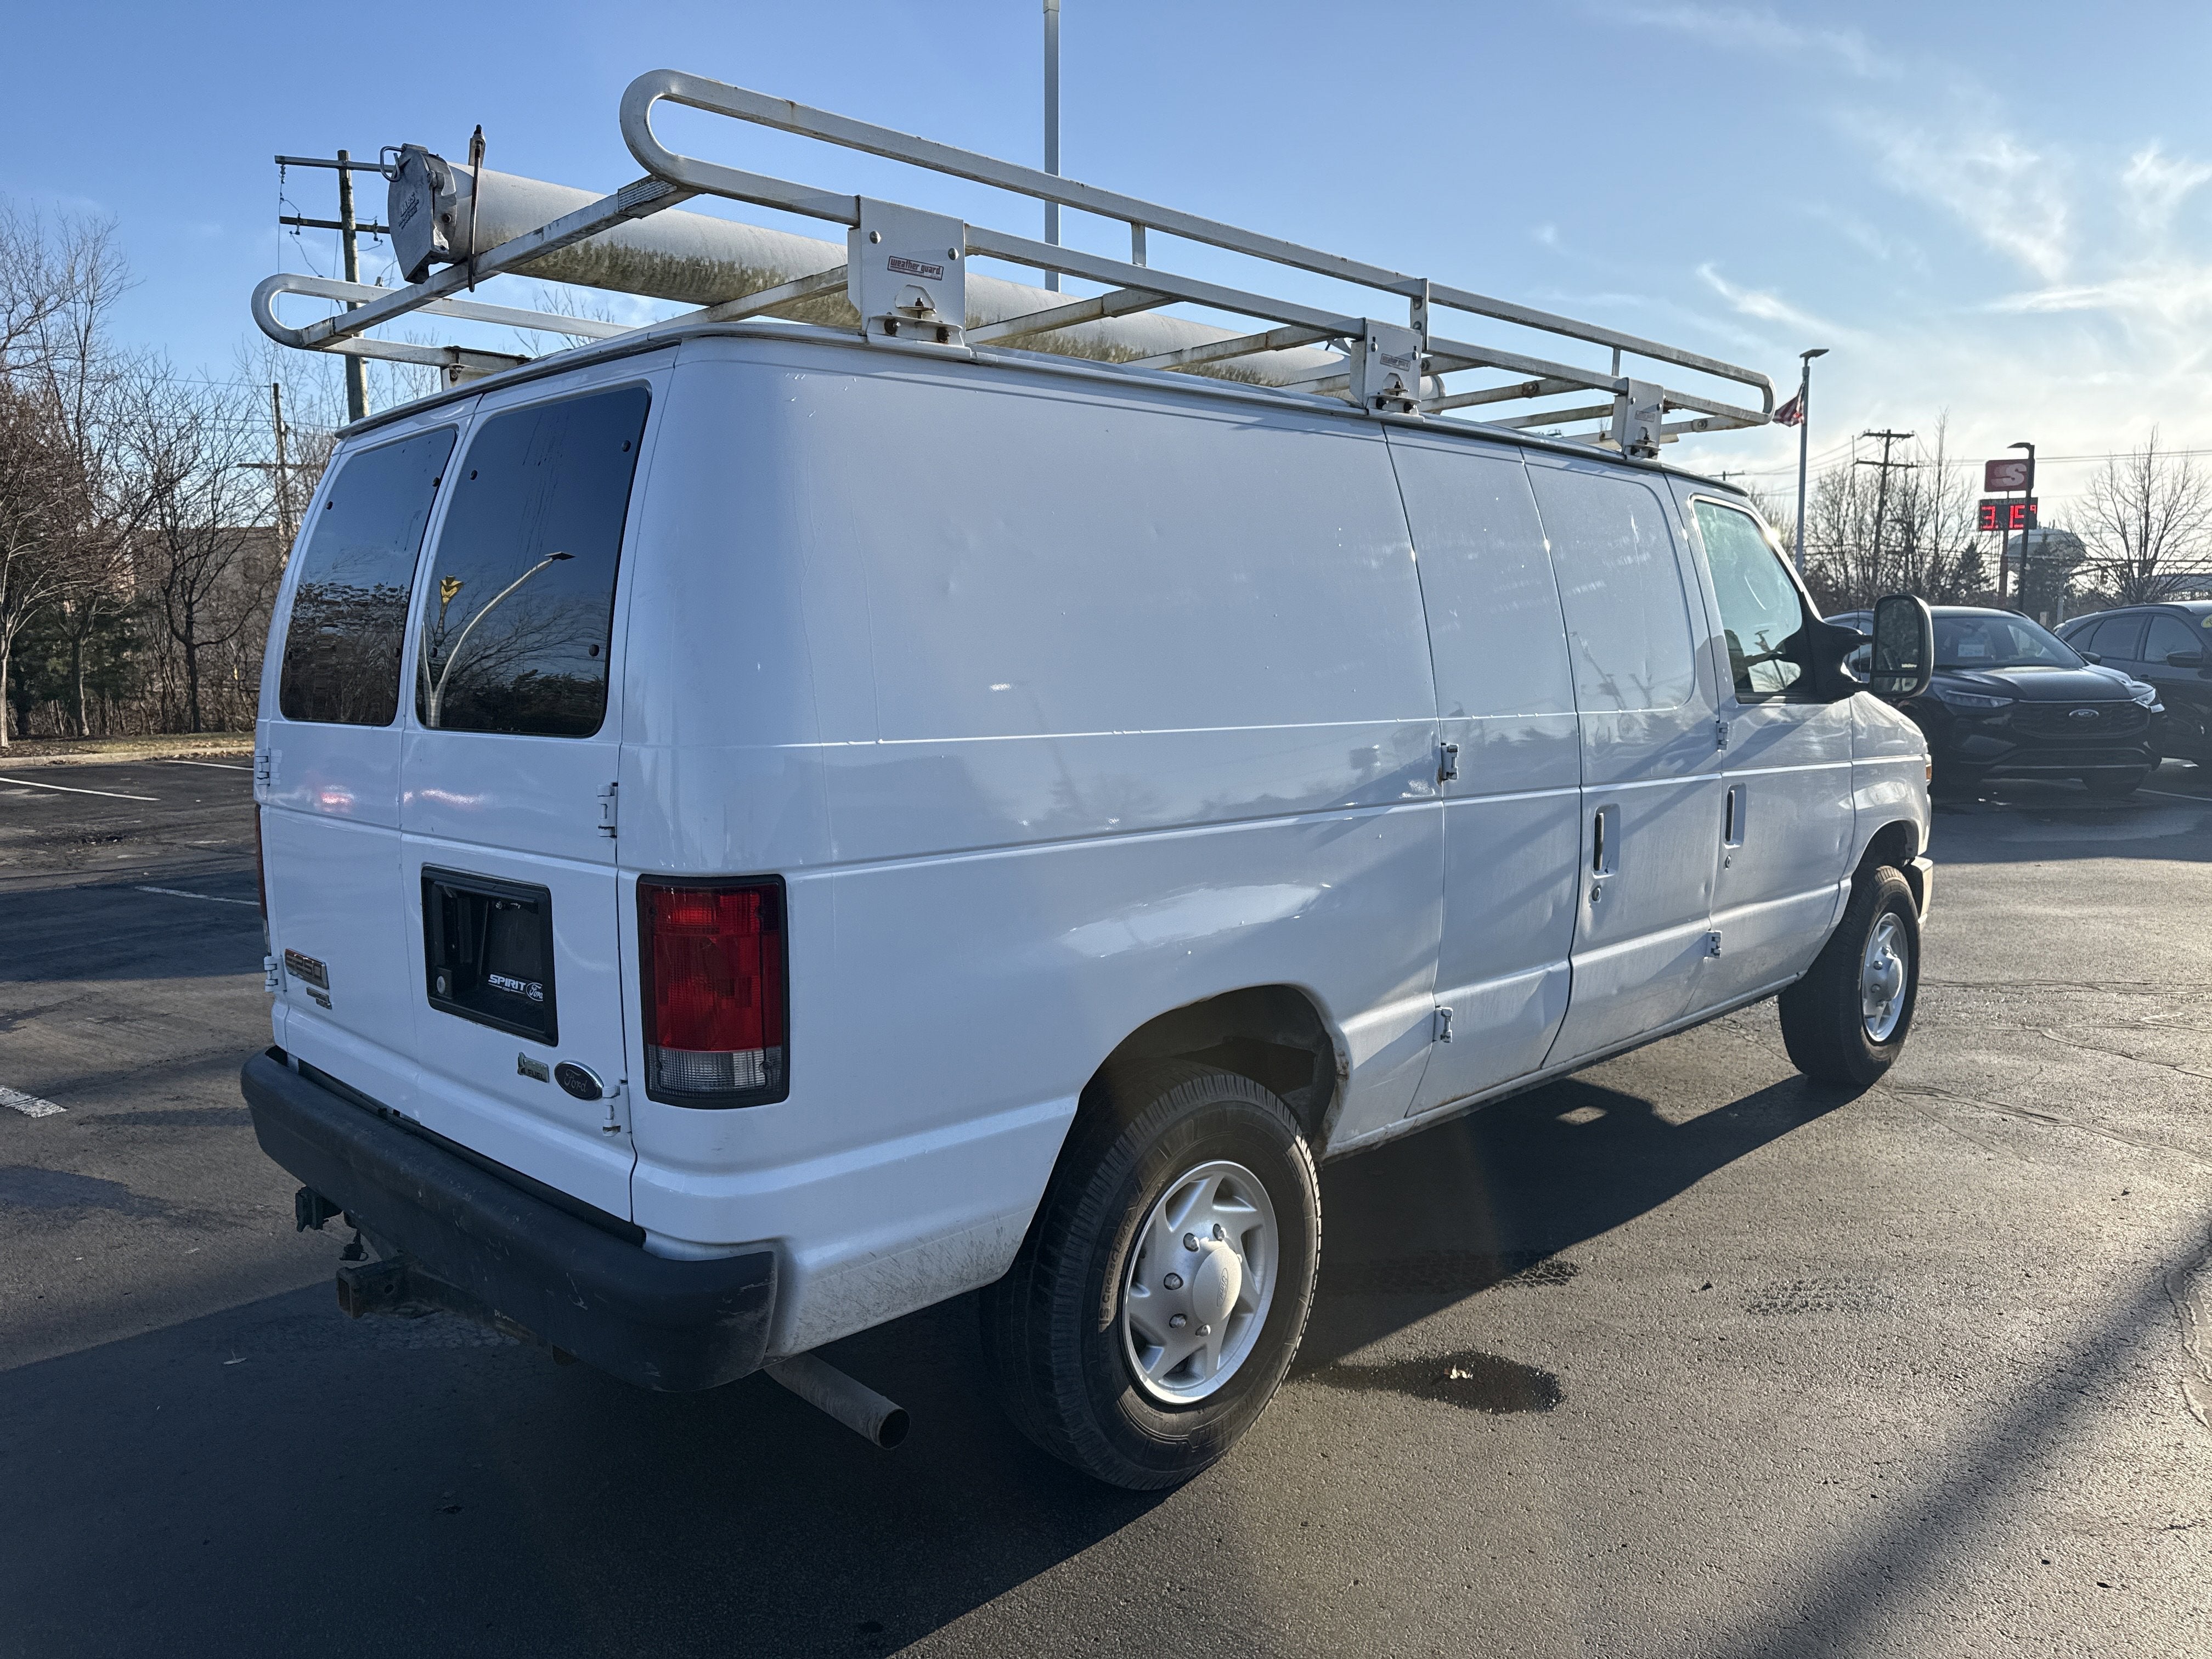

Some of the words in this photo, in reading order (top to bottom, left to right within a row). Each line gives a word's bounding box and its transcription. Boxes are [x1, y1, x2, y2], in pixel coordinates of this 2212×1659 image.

[891, 259, 919, 270] weather
[488, 974, 526, 991] SPIRIT
[527, 1069, 546, 1081] FUEL
[564, 1069, 587, 1093] Ford
